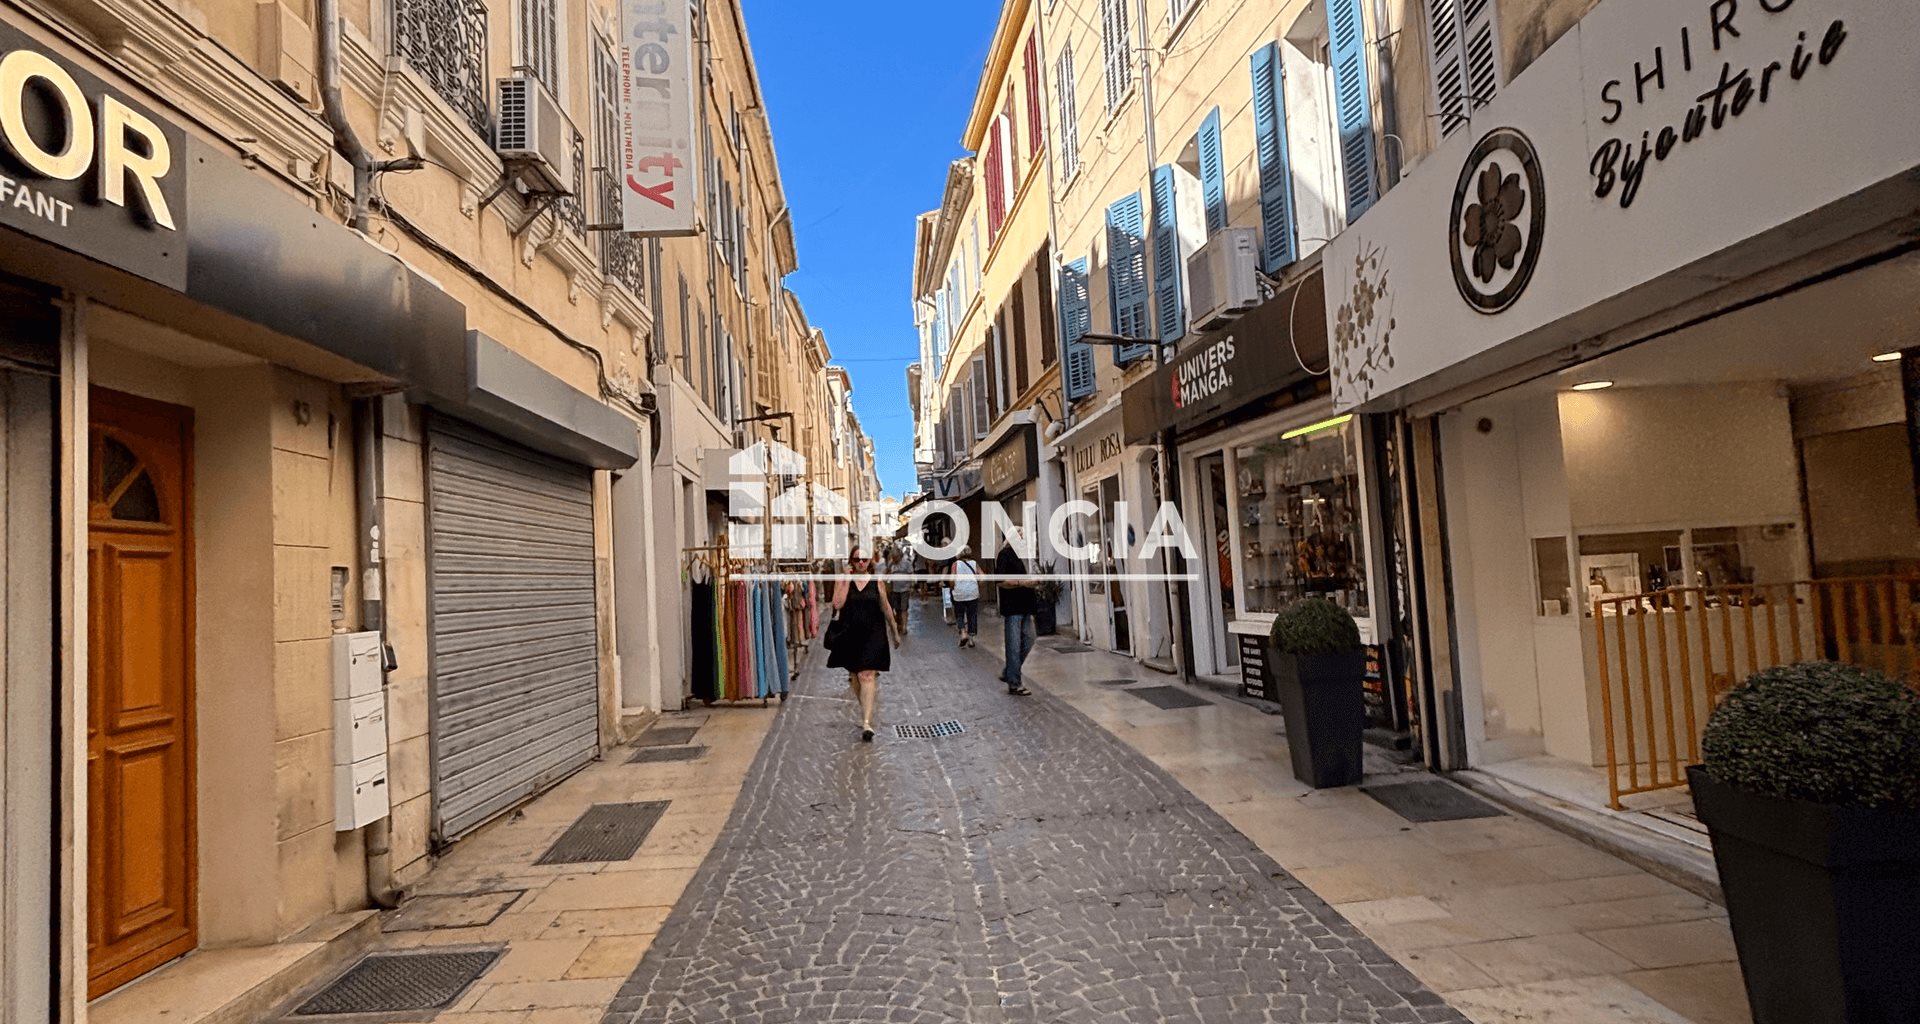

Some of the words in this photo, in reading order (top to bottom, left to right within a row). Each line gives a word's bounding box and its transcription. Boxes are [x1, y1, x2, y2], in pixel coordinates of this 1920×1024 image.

[621, 46, 631, 104] TELEPHONIE
[624, 112, 634, 170] MULTIMEDIA
[1590, 20, 1848, 208] Bijouterie
[1179, 335, 1235, 386] UNIVERS
[1180, 365, 1229, 408] MANGA
[1076, 443, 1096, 473] LULU
[1100, 432, 1122, 463] ROSA
